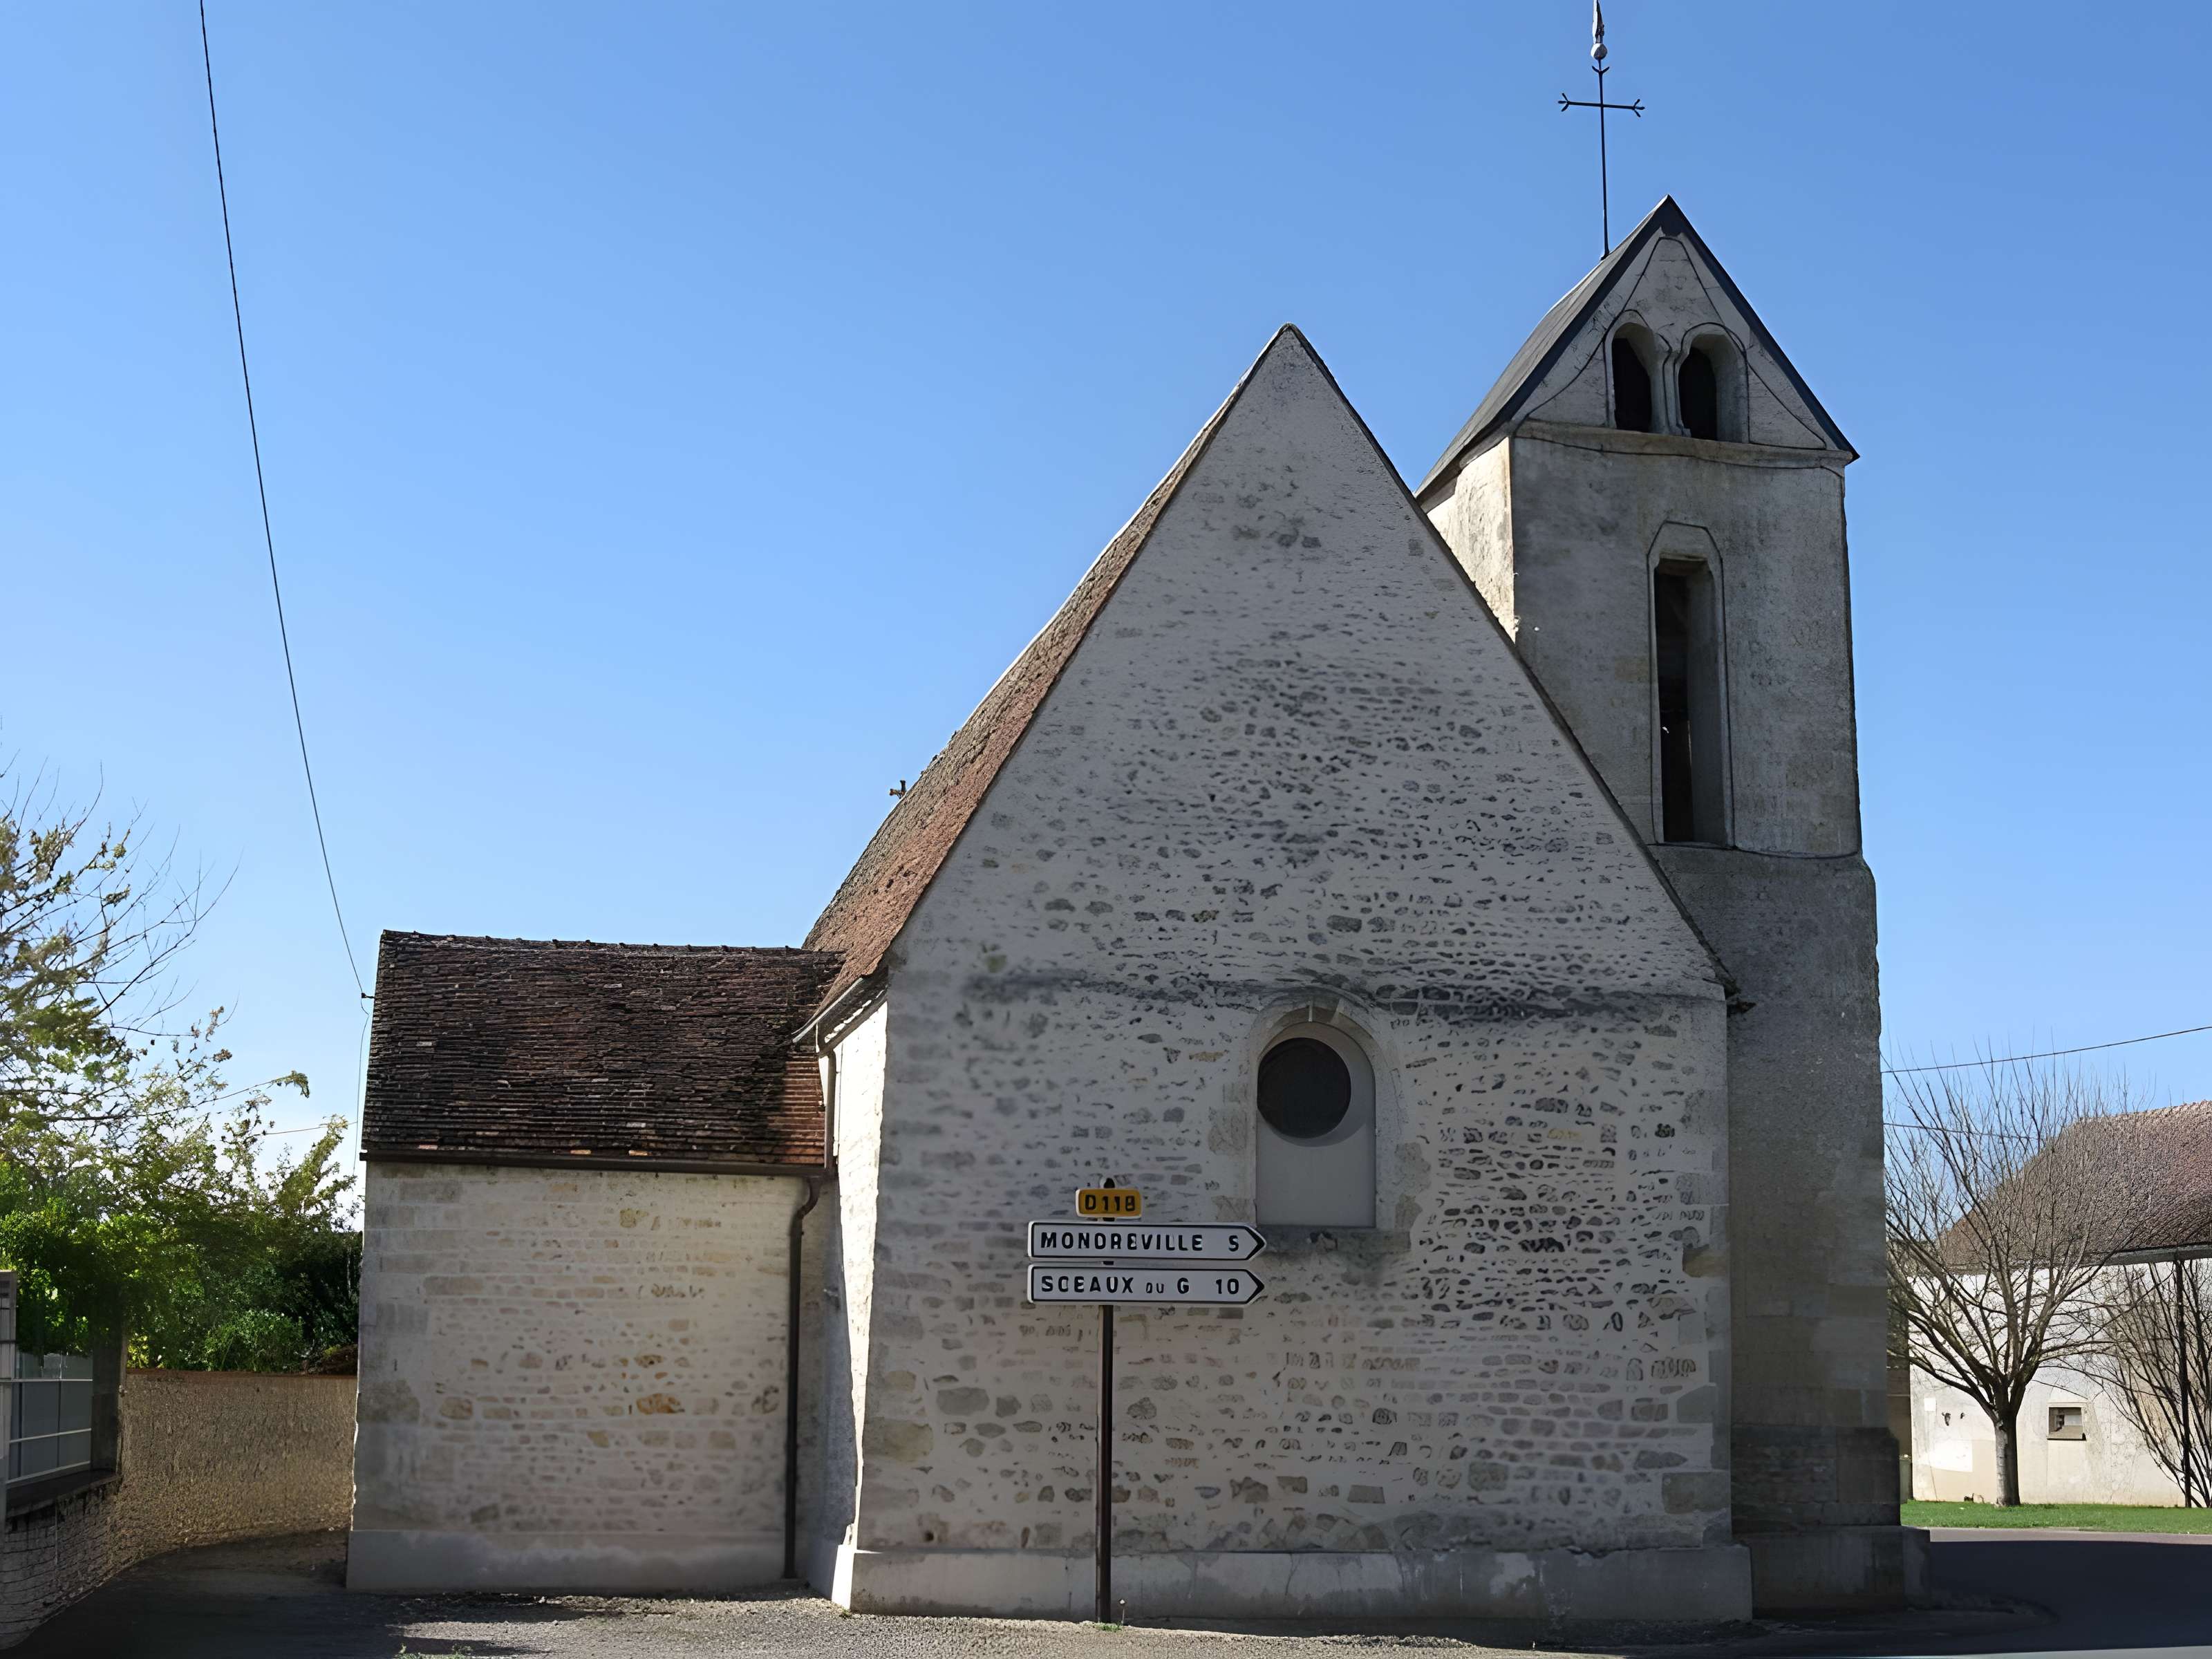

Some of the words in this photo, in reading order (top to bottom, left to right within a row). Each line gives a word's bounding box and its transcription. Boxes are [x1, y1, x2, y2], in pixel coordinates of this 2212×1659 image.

[1084, 1194, 1136, 1212] D118
[1040, 1232, 1203, 1250] MONDREVILLE
[1041, 1275, 1134, 1293] SCEAUX
[1177, 1277, 1190, 1294] G
[1215, 1279, 1239, 1295] 10
